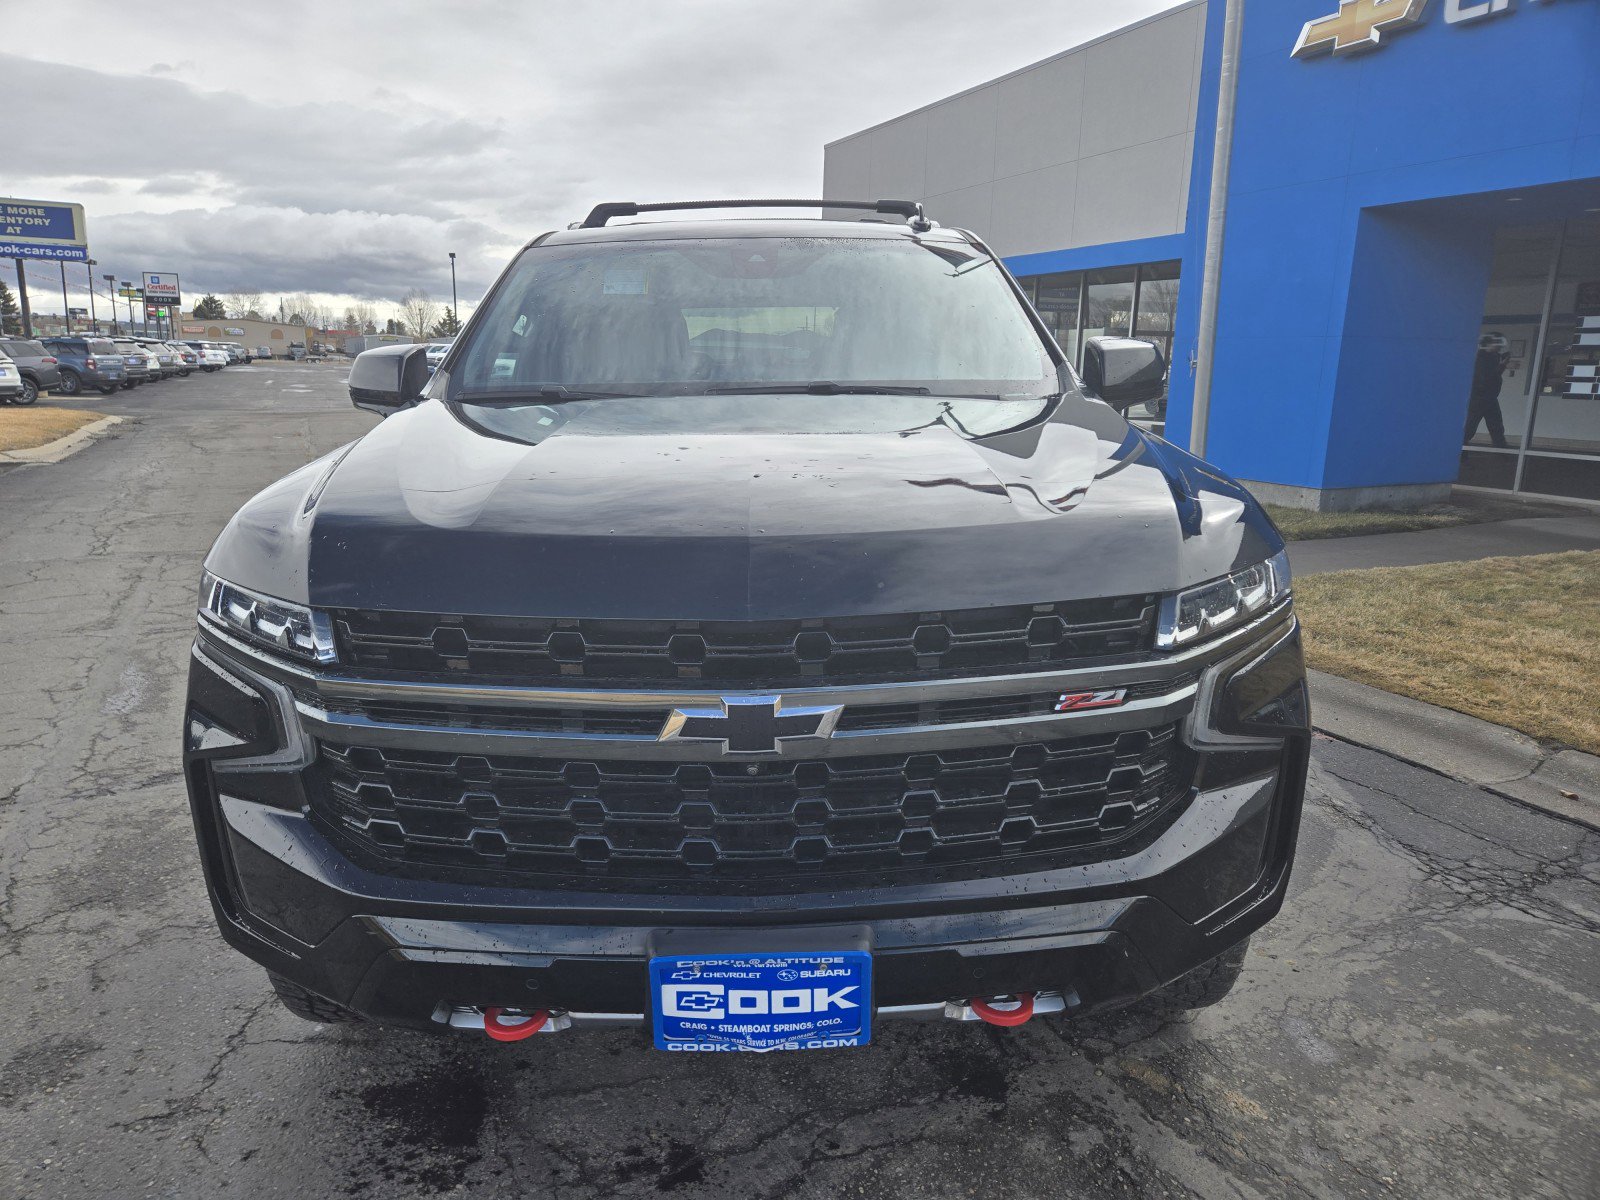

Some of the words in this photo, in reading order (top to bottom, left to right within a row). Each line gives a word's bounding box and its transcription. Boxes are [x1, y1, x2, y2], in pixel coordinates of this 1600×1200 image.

[7, 206, 45, 216] MORE
[6, 226, 22, 234] AT
[765, 957, 844, 965] ALTITUDE
[800, 969, 851, 978] SUBARU
[661, 984, 860, 1019] COOK
[679, 1021, 707, 1030] CRAIG
[718, 1024, 771, 1033] STEAMBOAT
[816, 1017, 843, 1027] COLO.
[747, 1039, 767, 1047] SERVICE
